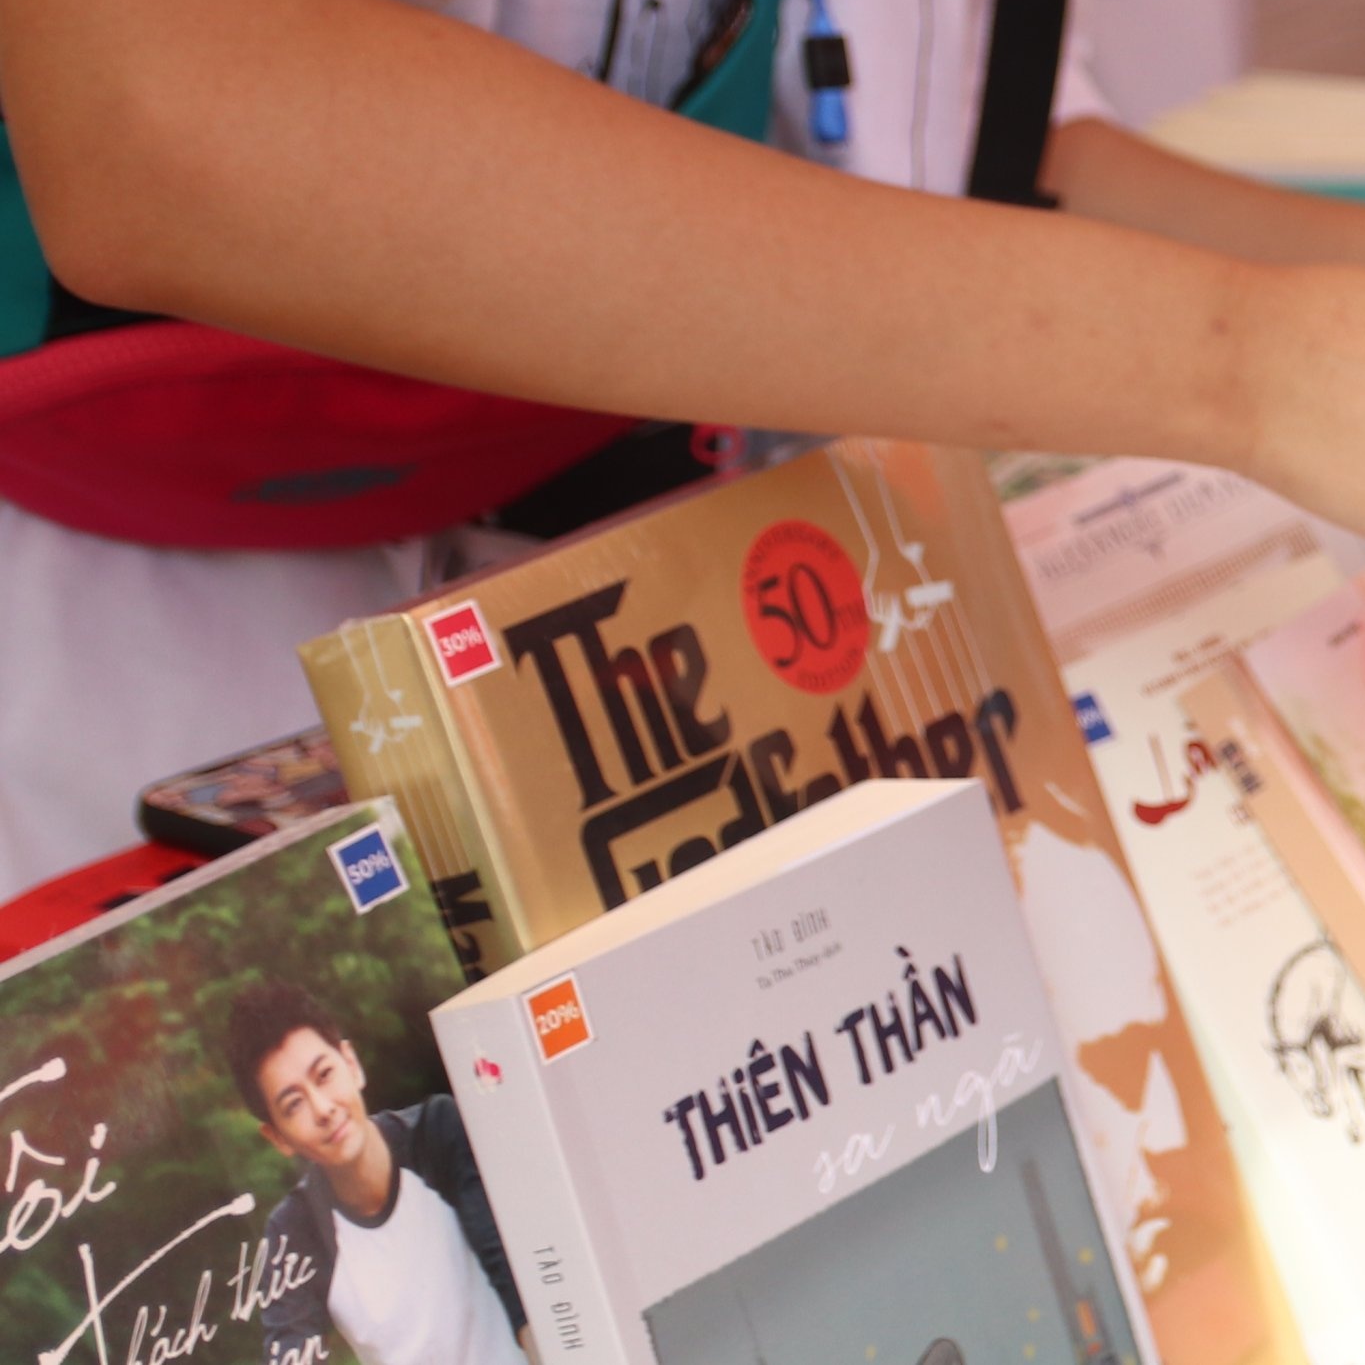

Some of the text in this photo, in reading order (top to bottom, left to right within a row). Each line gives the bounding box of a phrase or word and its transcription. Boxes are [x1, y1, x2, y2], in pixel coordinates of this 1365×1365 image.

[439, 625, 485, 658] 30%
[757, 561, 838, 669] 50
[501, 578, 731, 812] The
[347, 849, 393, 885] 50%
[536, 1001, 580, 1036] 20%
[533, 1245, 584, 1351] TÀO ĐÌNH
